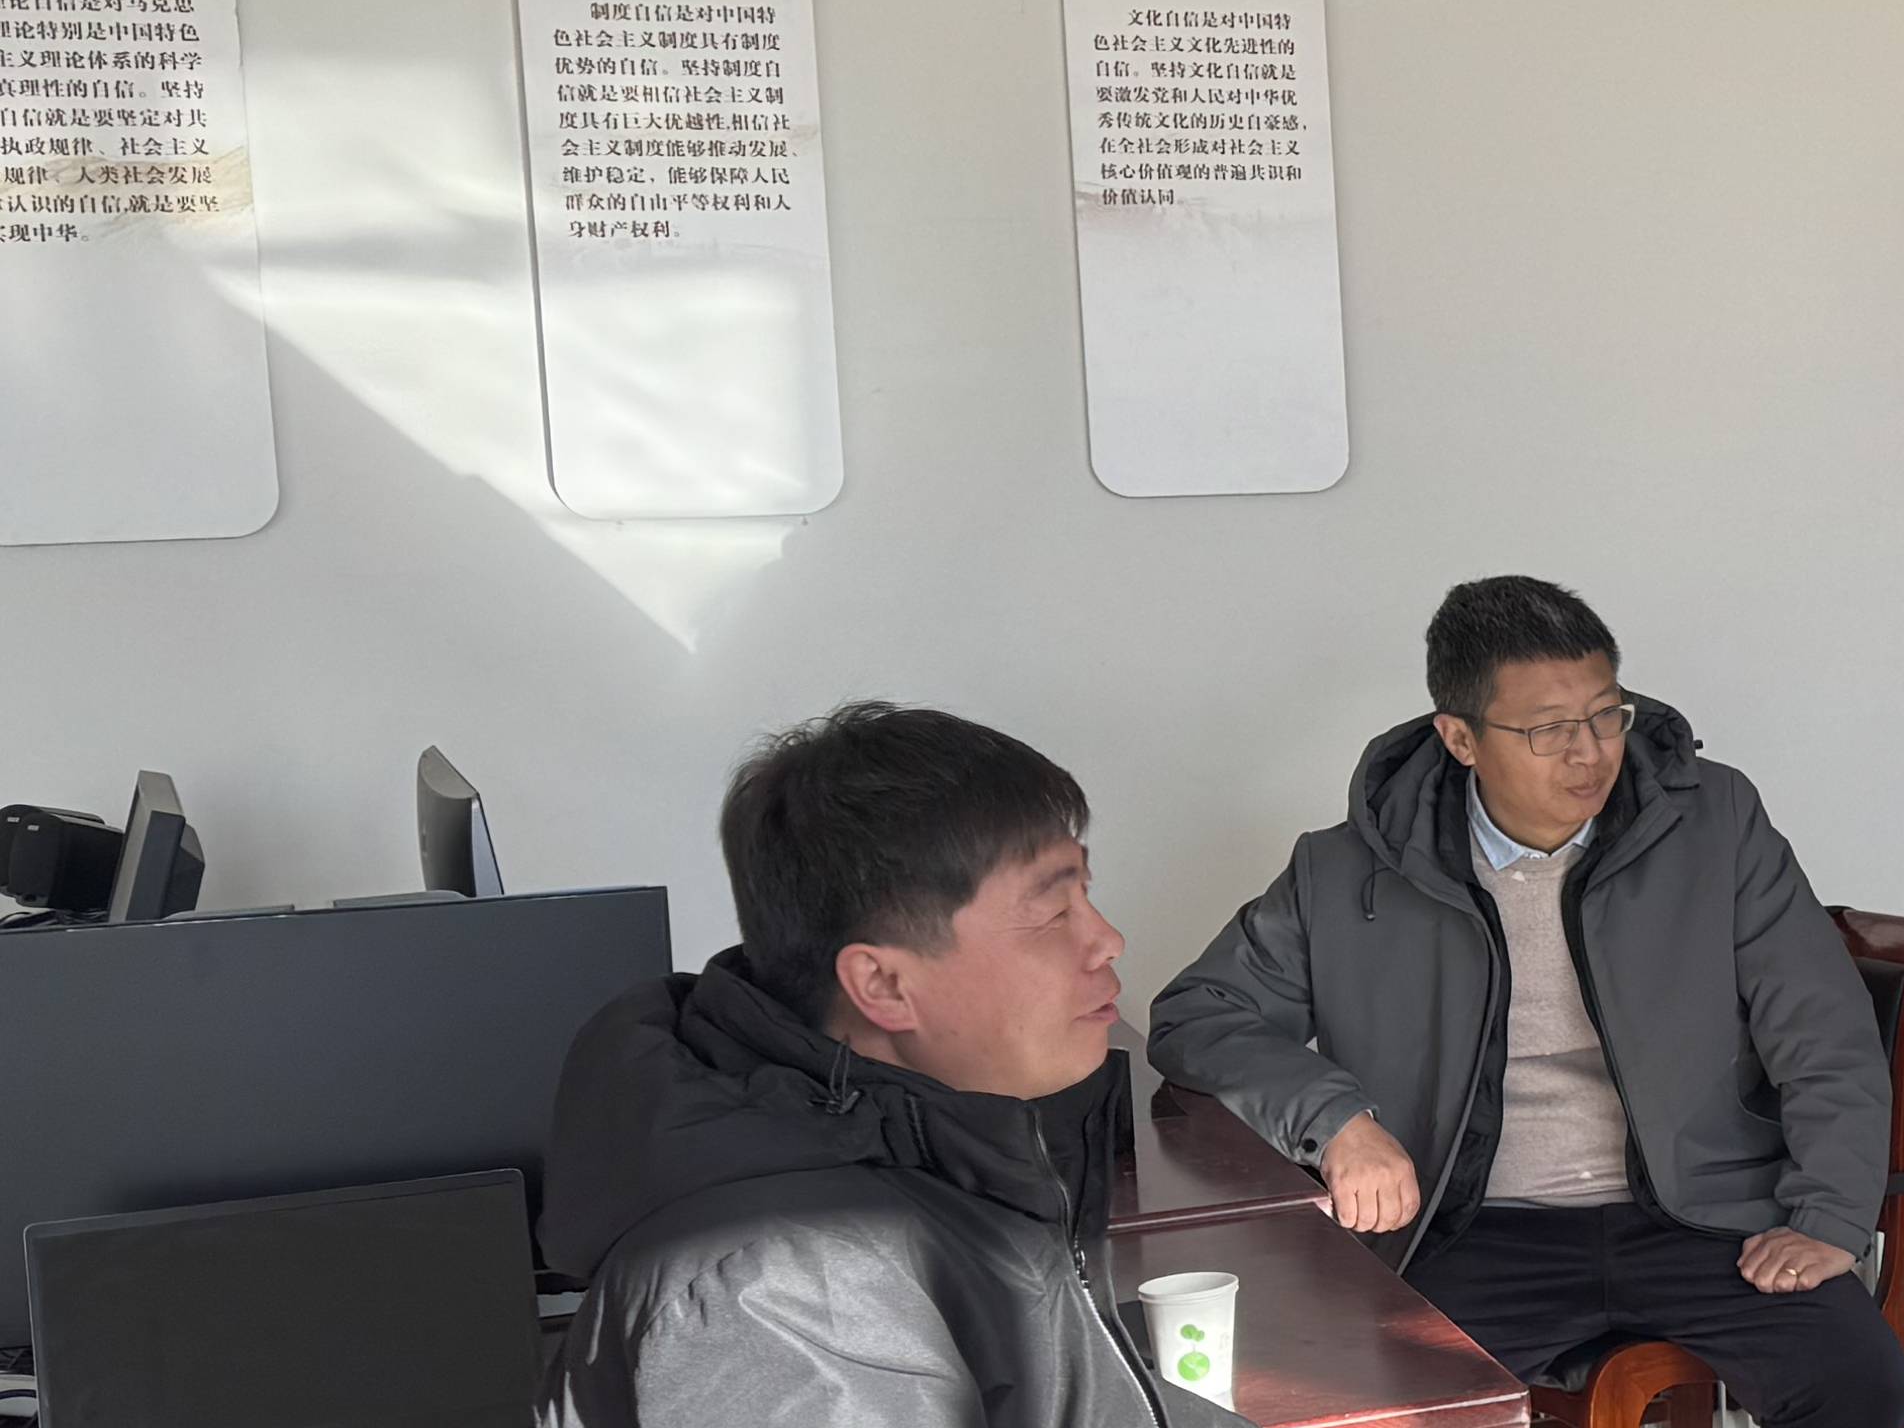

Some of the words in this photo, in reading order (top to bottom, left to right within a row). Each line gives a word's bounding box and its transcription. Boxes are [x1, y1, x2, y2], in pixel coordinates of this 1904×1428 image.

[590, 3, 776, 24] 制度自信是对中国特
[1128, 9, 1291, 29] 文化自信是对中国特
[553, 29, 780, 50] 色社会主义制度具有制度
[1094, 35, 1294, 55] 色社会主义文化先进性的
[555, 57, 780, 78] 优势的自信。坚持制度自
[1096, 61, 1296, 81] 自信。坚持文化自信就是
[557, 84, 783, 105] 信就是要相信社会主义制
[1096, 86, 1298, 106] 要激发党和人民对中华优
[0, 107, 207, 128] 自信就是要坚定对共
[1098, 111, 1307, 130] 秀传统文化的历史自豪感，
[1, 137, 209, 156] 执政规律、社会主义
[561, 139, 799, 157] 会主义制度能够推动发展、
[1099, 137, 1300, 156] 在全社会形成对社会主义
[4, 166, 212, 185] 规律、人类社会发展
[563, 166, 789, 185] 维护稳定，能够保障人民
[1100, 163, 1302, 181] 核心价值观的普遍共识和
[566, 193, 791, 212] 群众的自由平等权利和人
[0, 223, 89, 243] 现中华。
[569, 221, 680, 238] 身财产权利。
